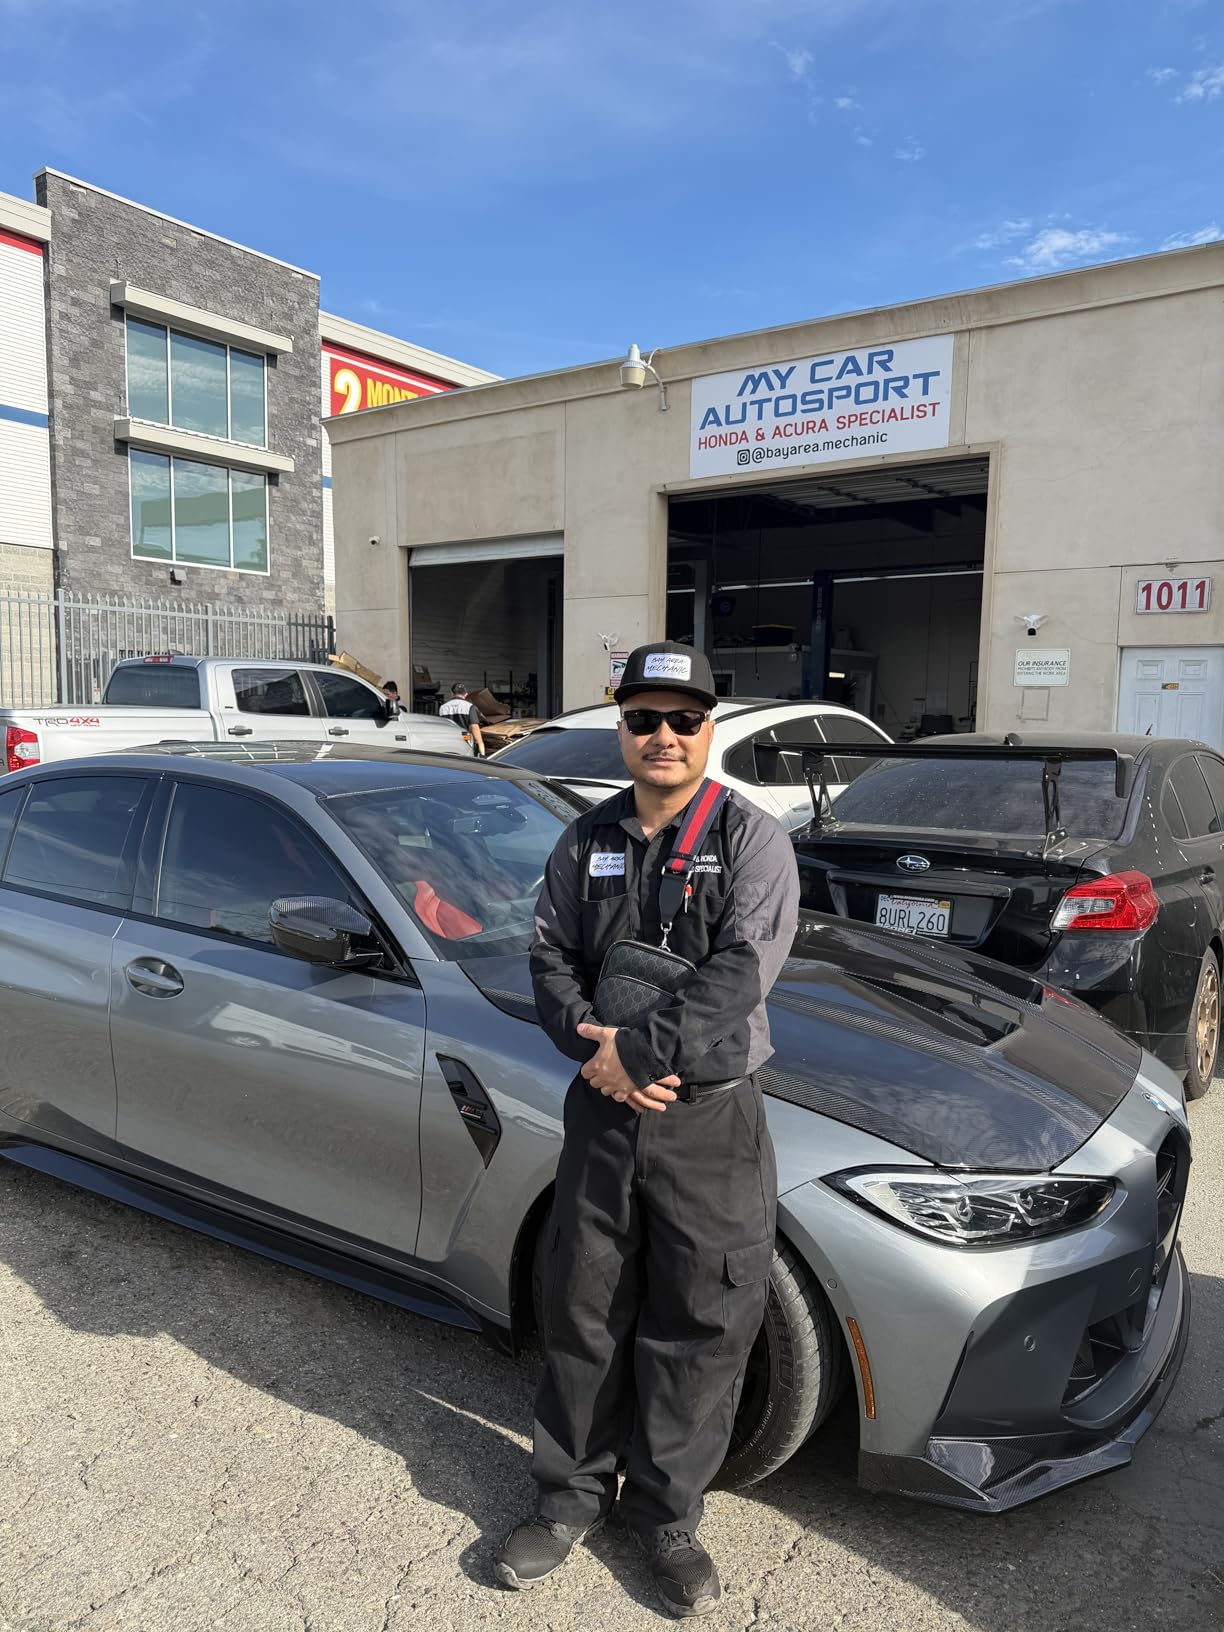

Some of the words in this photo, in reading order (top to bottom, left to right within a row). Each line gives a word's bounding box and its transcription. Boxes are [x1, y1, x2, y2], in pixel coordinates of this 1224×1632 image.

[334, 368, 362, 414] 2
[737, 366, 797, 397] MY
[810, 349, 894, 384] CAR
[699, 370, 941, 430] AUTOSPORT
[698, 431, 749, 450] HONDA
[755, 428, 766, 441] &
[772, 418, 829, 439] ACURA
[836, 402, 941, 430] SPECIALIST
[752, 431, 888, 463] @bayarea.mechanic
[1142, 580, 1206, 611] 1011
[647, 664, 689, 674] MECHANIC
[880, 907, 946, 932] 8URL260
